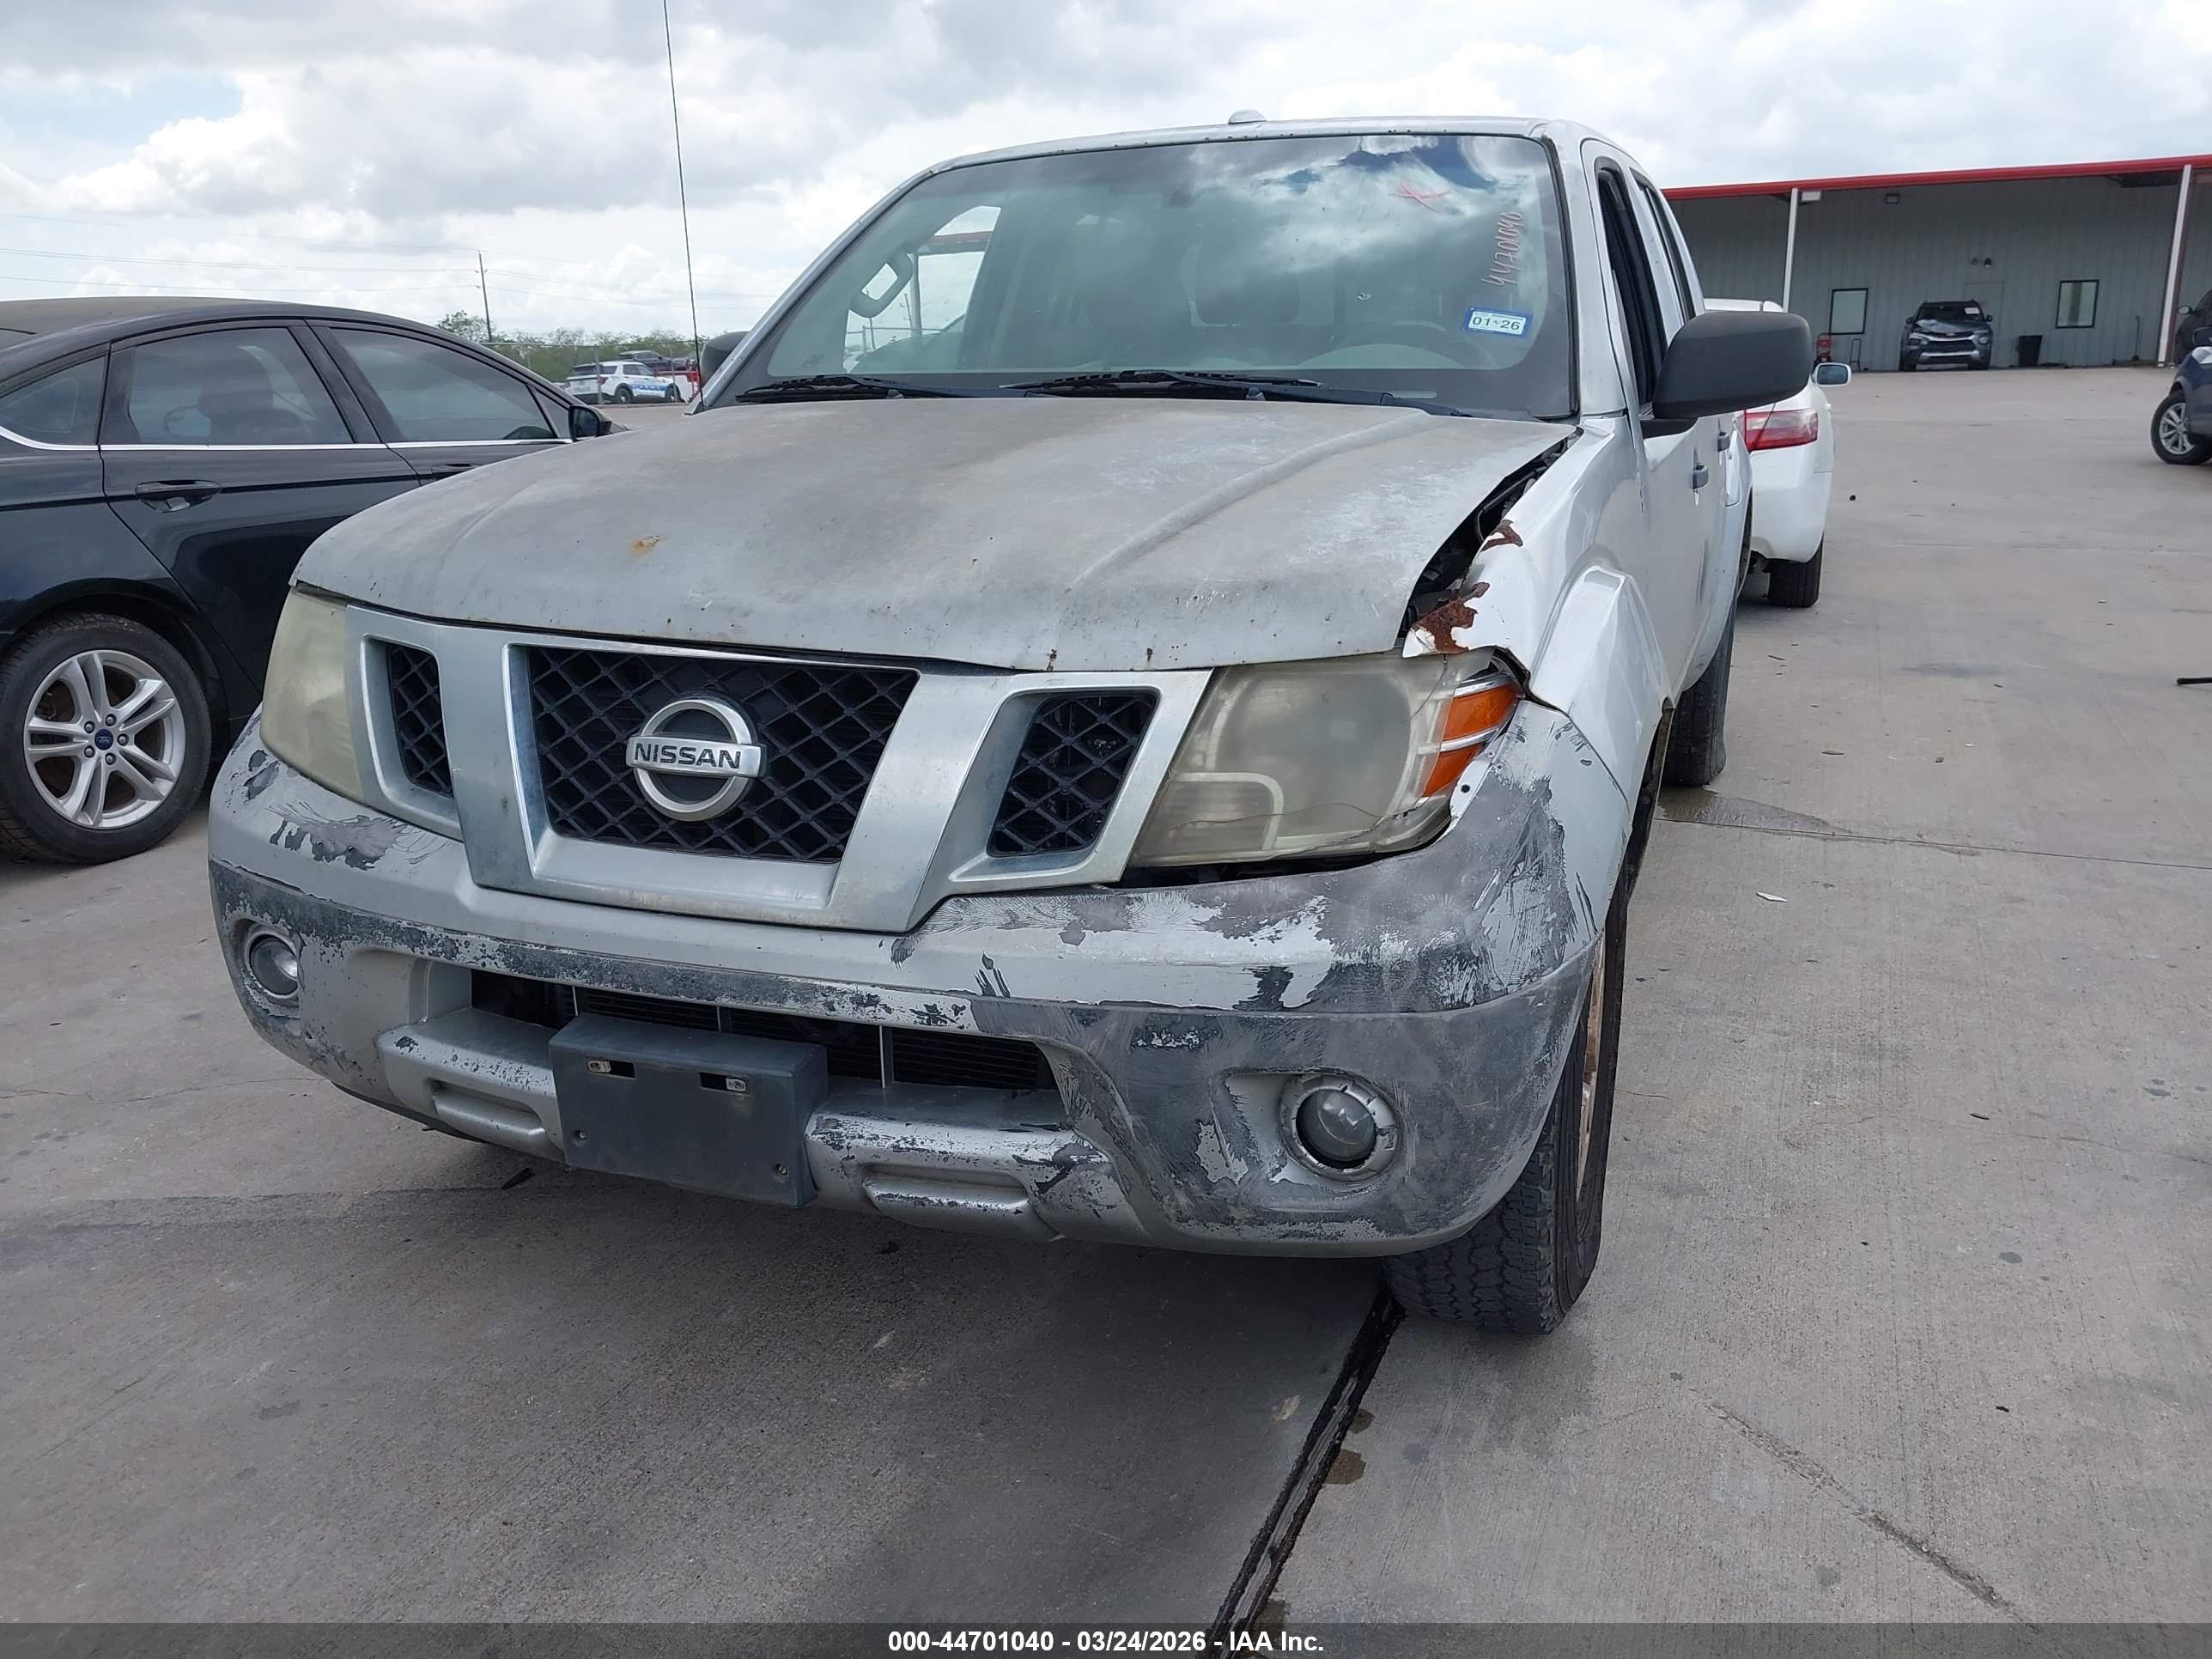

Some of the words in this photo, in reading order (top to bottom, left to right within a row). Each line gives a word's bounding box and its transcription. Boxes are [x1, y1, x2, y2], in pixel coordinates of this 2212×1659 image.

[1480, 212, 1523, 286] 44701040
[1472, 316, 1491, 326] 01
[1499, 319, 1521, 331] 26
[634, 742, 742, 769] NISSAN
